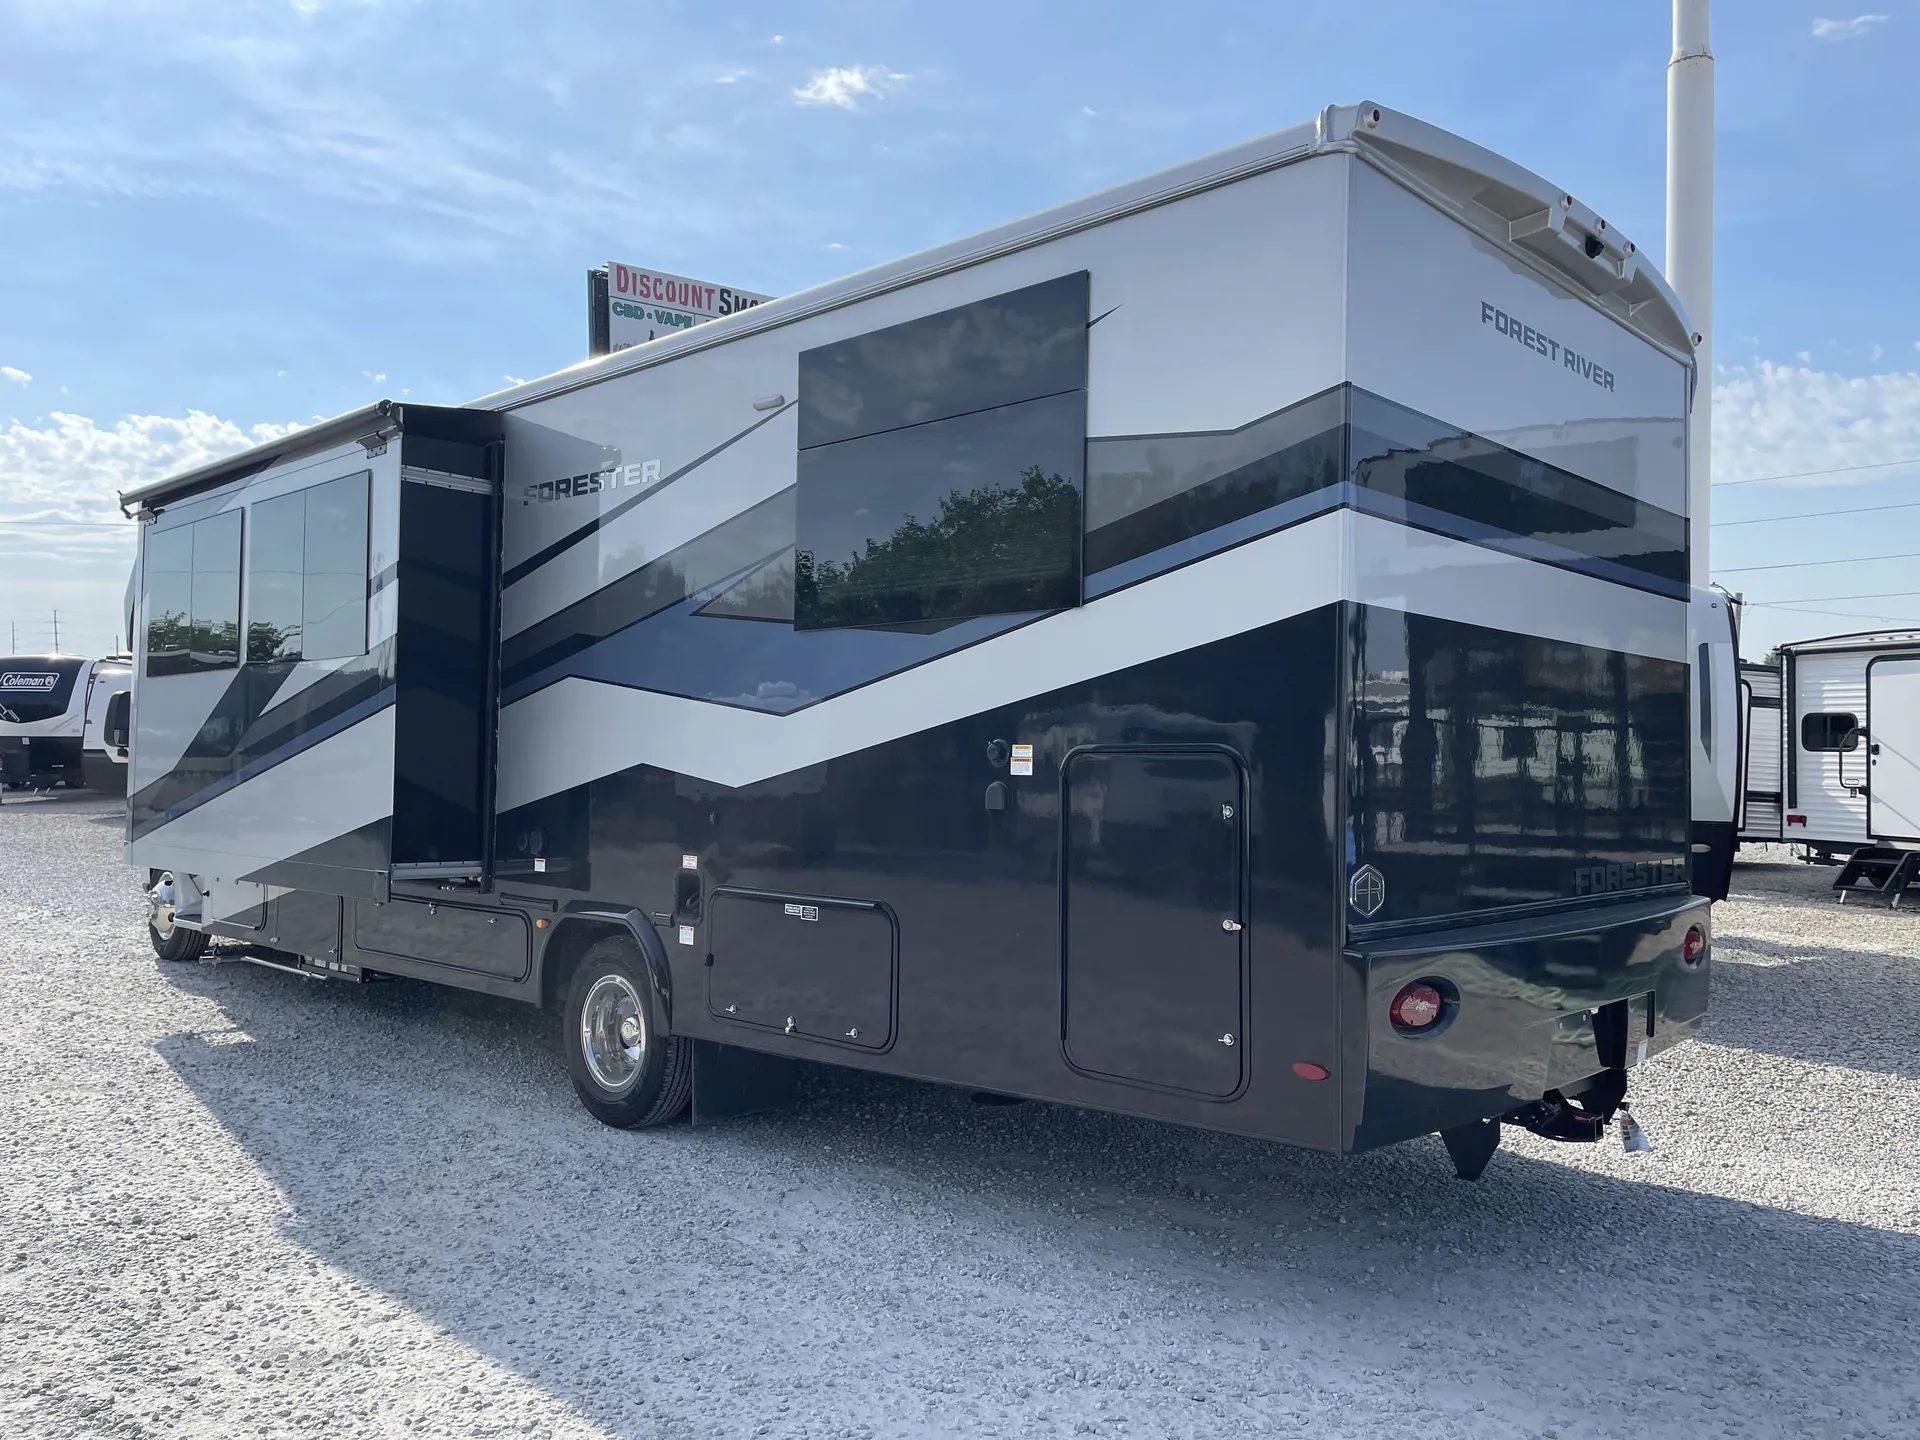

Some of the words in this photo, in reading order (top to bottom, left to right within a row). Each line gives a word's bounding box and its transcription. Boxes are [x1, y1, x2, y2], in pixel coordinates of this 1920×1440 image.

[616, 264, 716, 310] DISCOUNT
[719, 288, 765, 316] SM
[612, 301, 645, 320] CBD
[654, 309, 694, 329] VAPE
[1480, 300, 1560, 361] FOREST
[1563, 347, 1615, 393] RIVER
[523, 458, 662, 506] FORESTER
[2, 674, 45, 686] Coleman
[1574, 857, 1686, 896] FORESTER
